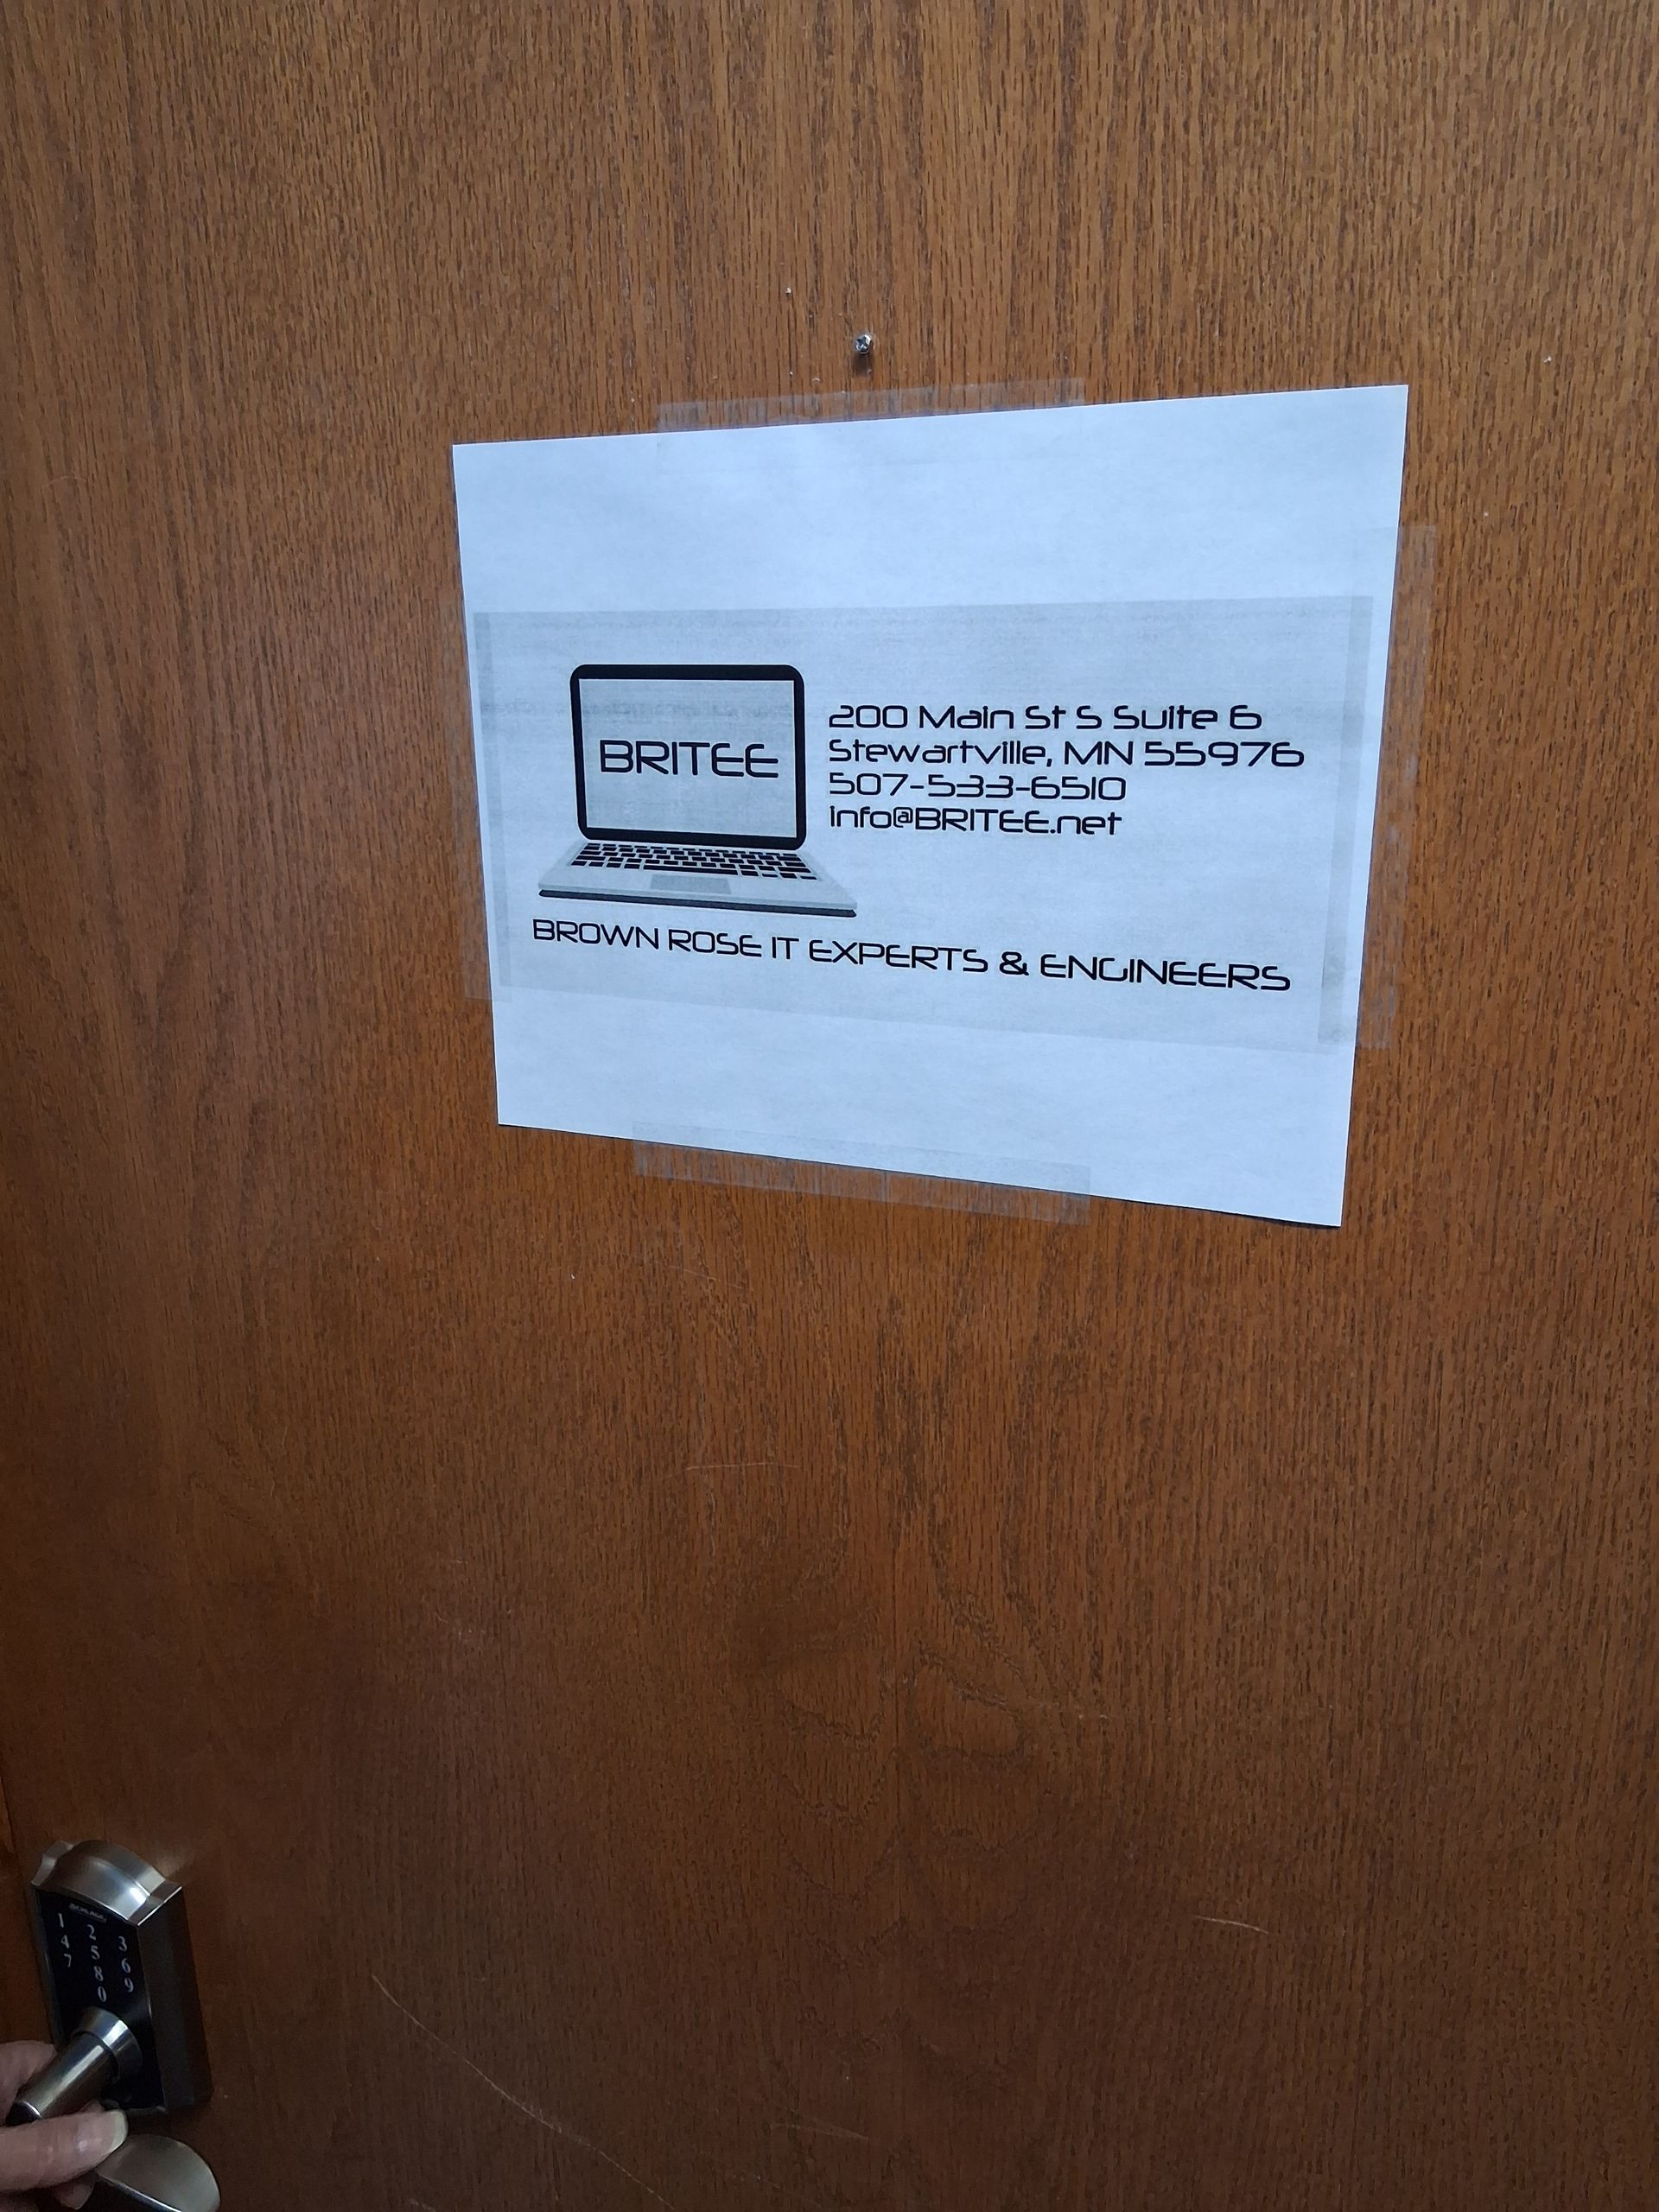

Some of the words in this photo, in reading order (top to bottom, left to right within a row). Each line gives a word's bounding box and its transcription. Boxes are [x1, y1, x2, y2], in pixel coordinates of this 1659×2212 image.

[828, 703, 909, 730] 200
[918, 704, 1015, 730] Main
[1024, 704, 1068, 730] St
[1075, 704, 1103, 731] S
[1112, 703, 1219, 731] Suite
[1229, 703, 1263, 731] 6
[598, 738, 780, 779] BRITEE
[828, 738, 1053, 768] Stewartville,
[1063, 740, 1135, 766] MN
[1143, 740, 1306, 768] 55976
[829, 771, 1128, 802] 507-533-6510
[531, 918, 660, 950] BROWN
[667, 928, 763, 958] ROSE
[771, 935, 801, 961] IT
[808, 938, 989, 974] EXPERTS
[998, 950, 1032, 977] &
[1039, 952, 1292, 993] ENGINEERS
[86, 1923, 98, 1941] 2
[118, 1936, 129, 1952] 3
[60, 1934, 70, 1949] 4
[90, 1944, 101, 1961] 5
[120, 1957, 132, 1974] 6
[63, 1952, 73, 1968] 7
[93, 1965, 105, 1982] 8
[124, 1978, 135, 1993] 9
[97, 1986, 108, 2003] 0
